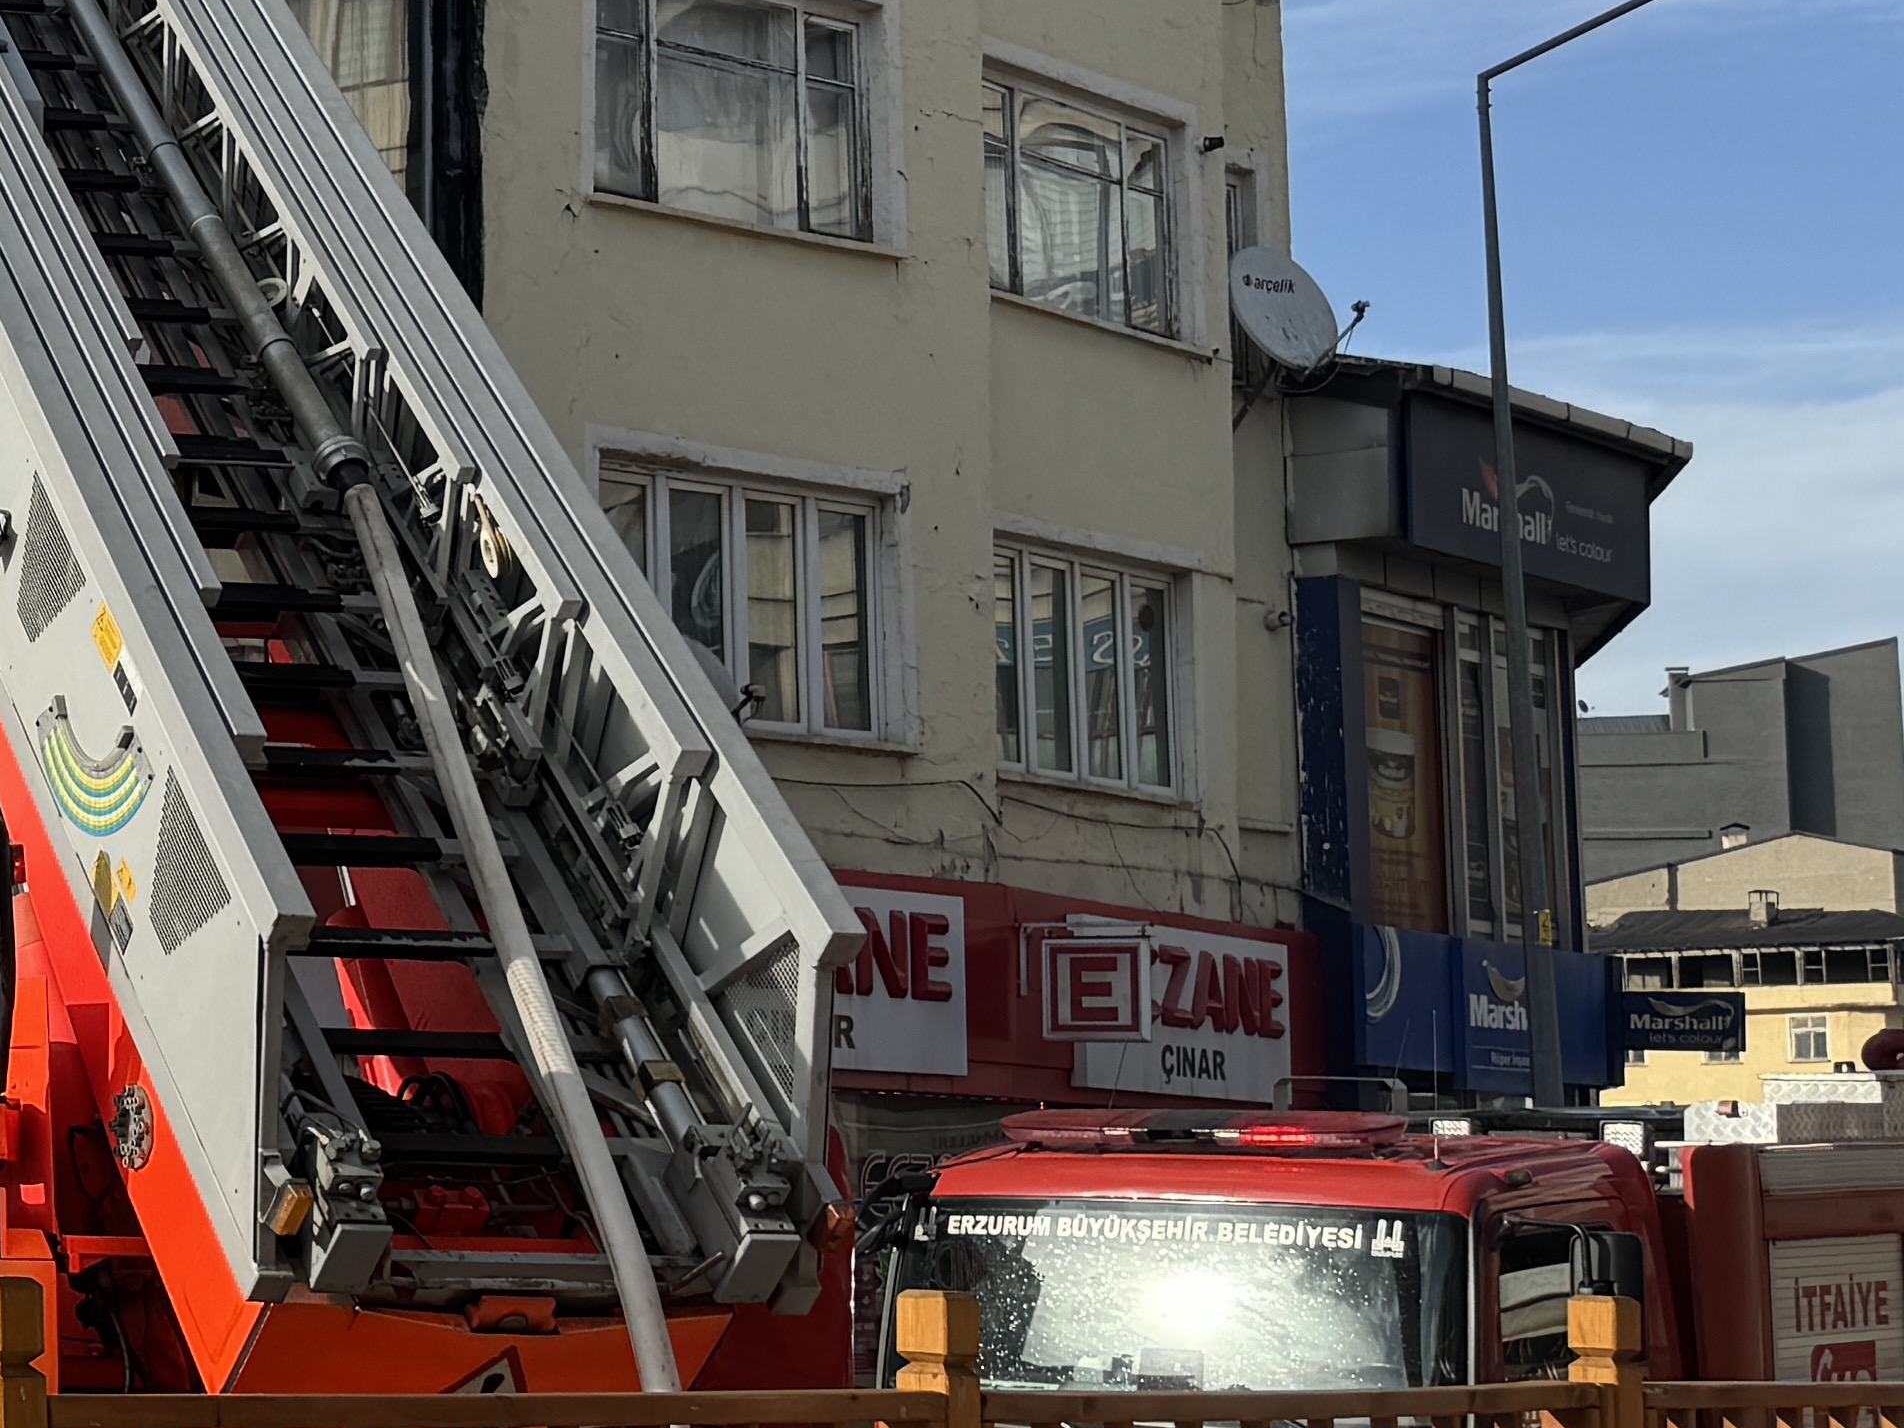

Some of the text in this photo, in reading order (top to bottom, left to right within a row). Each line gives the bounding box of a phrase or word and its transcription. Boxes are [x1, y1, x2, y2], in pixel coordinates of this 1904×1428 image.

[1461, 487, 1546, 545] Marall
[1468, 992, 1529, 1032] Marsh
[1629, 1013, 1725, 1032] Marshall
[1160, 1045, 1227, 1085] ÇINAR
[947, 1212, 1363, 1251] ERZURUM BÜYÜKŞEHİR BELEDİYESİ
[1794, 1273, 1890, 1333] İTFAİYE
